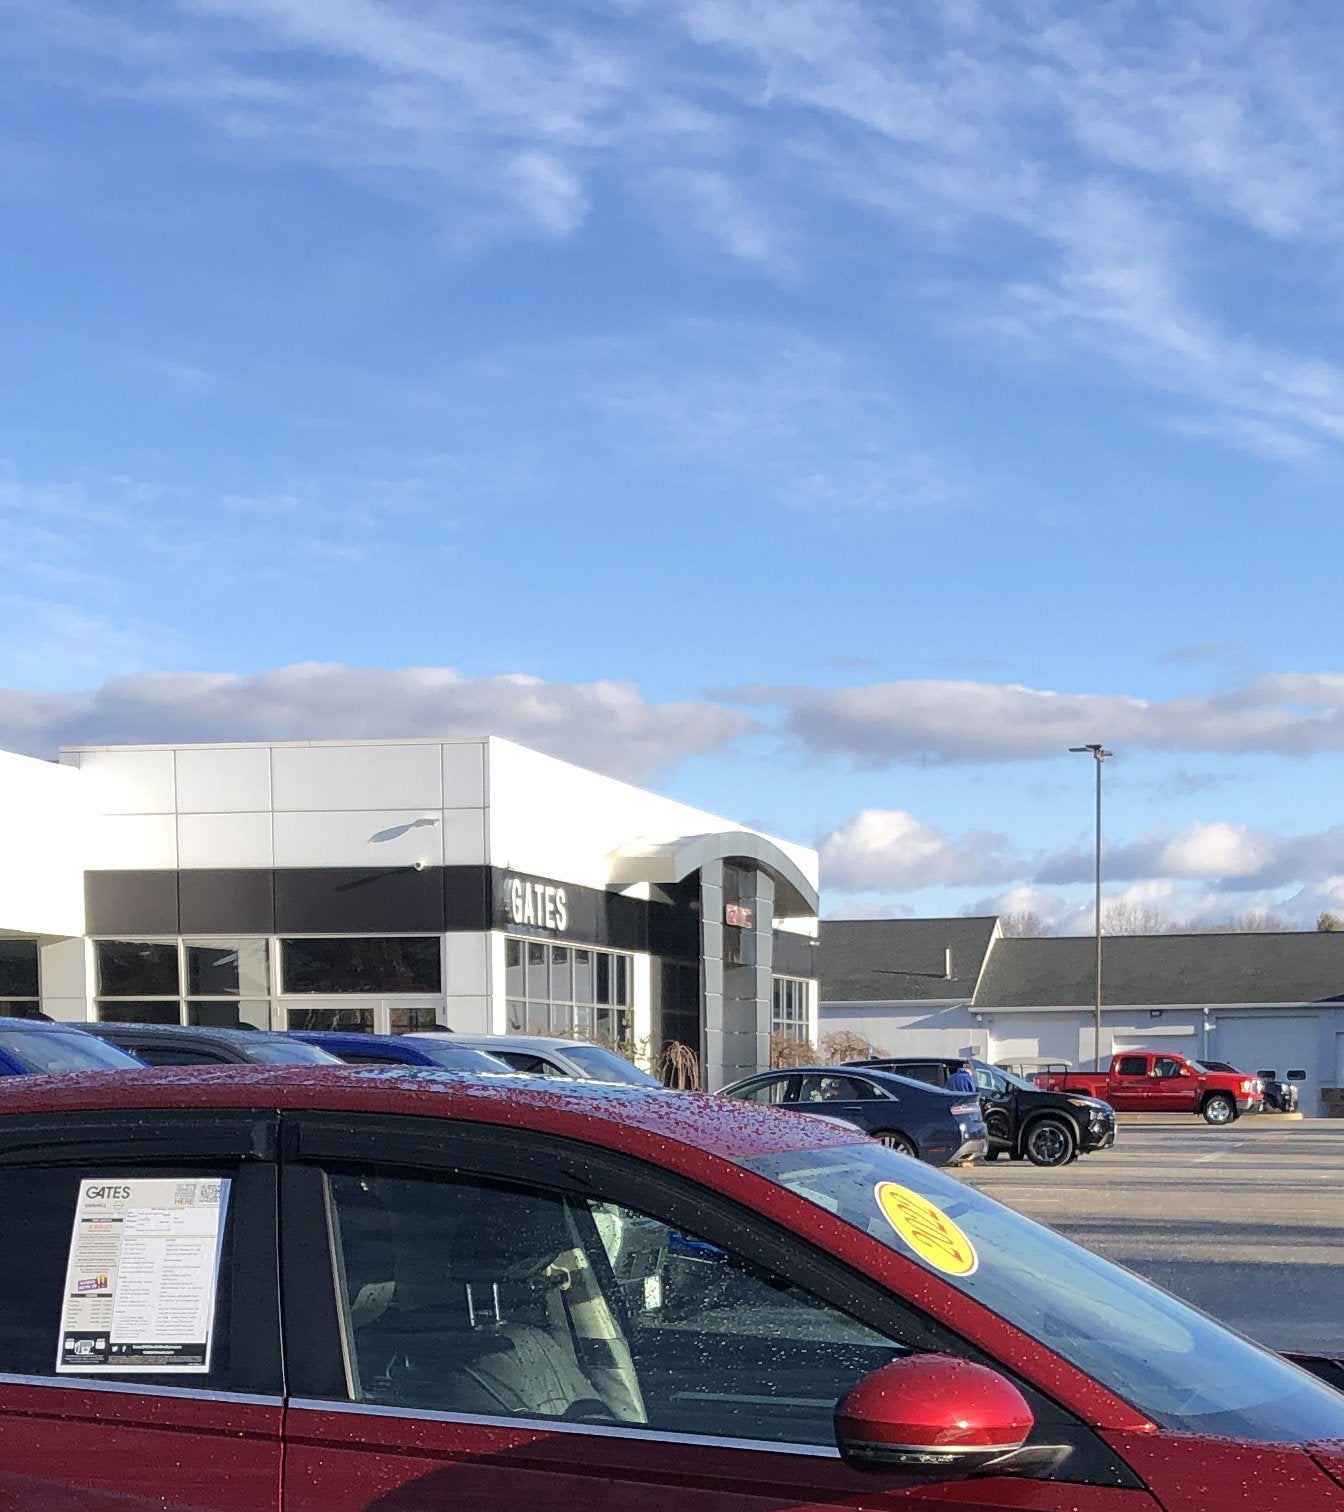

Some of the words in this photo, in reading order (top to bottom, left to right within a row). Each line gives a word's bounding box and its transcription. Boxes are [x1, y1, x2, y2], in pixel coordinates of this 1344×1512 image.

[512, 878, 567, 931] GATES
[85, 1185, 131, 1200] GATES
[888, 1191, 965, 1264] 2022
